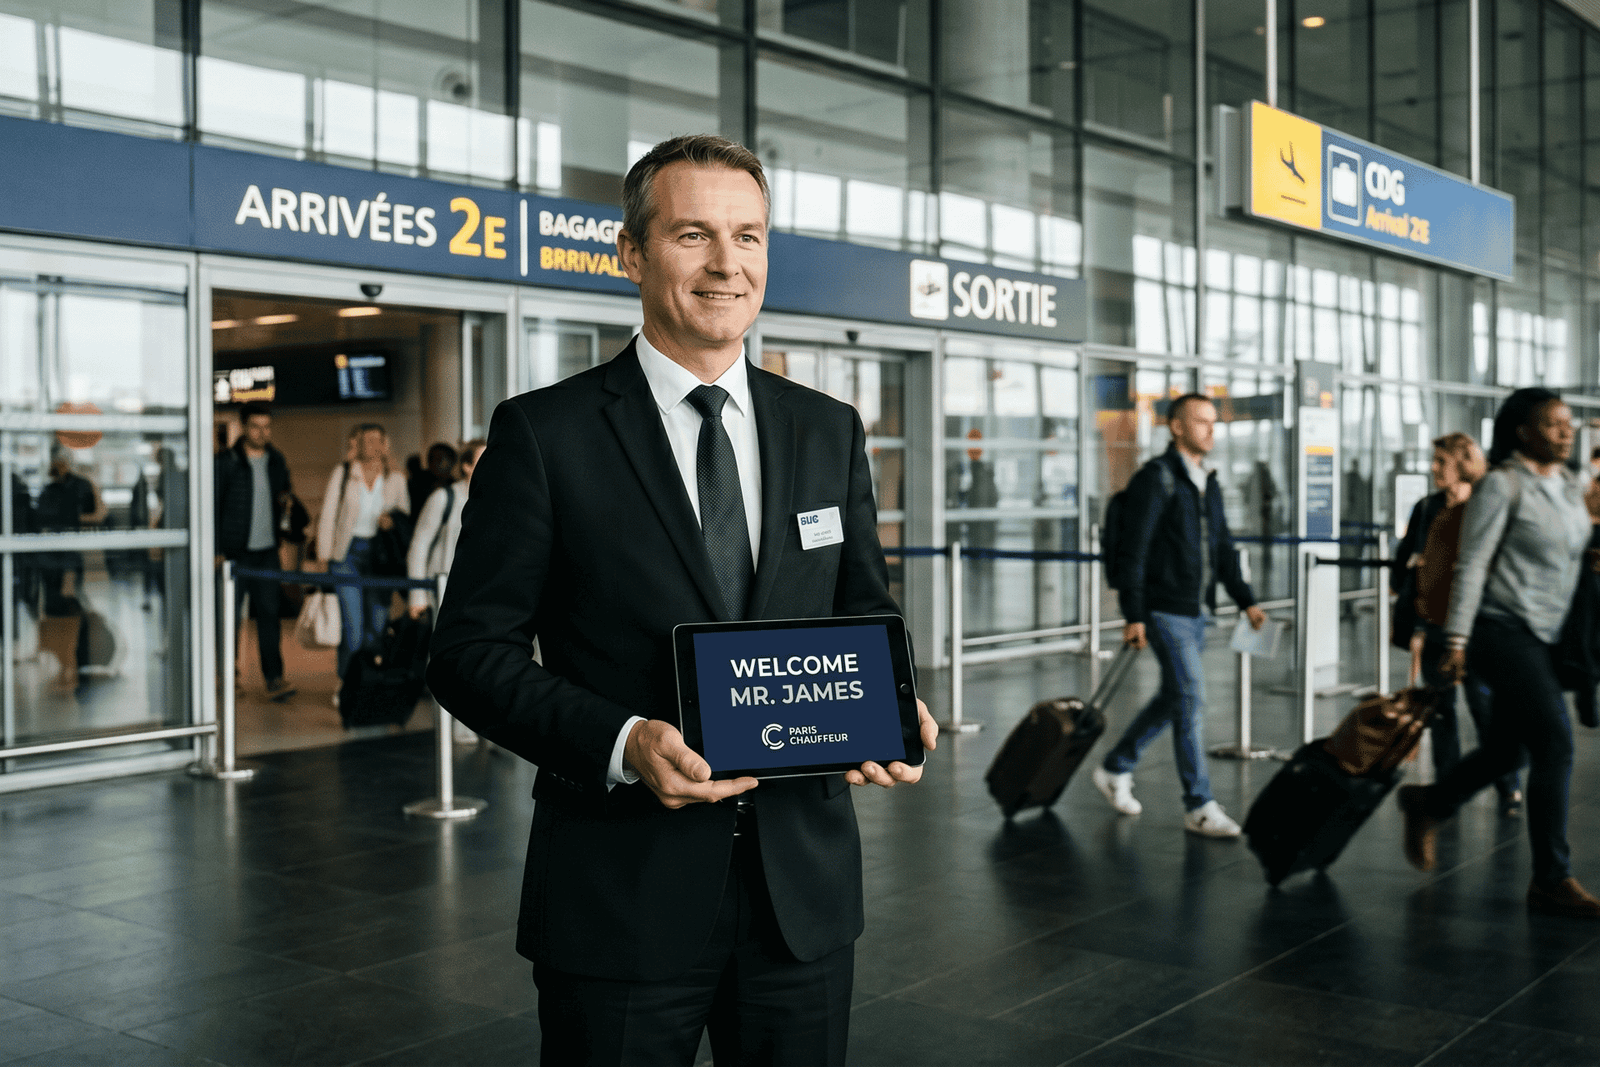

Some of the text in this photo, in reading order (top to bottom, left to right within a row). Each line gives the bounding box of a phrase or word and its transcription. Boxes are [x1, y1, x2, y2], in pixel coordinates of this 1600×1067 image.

[1365, 161, 1406, 206] CDG
[235, 184, 507, 259] ARRIVÉES 2E
[952, 271, 1057, 328] SORTIE
[730, 653, 859, 678] WELCOME
[730, 680, 864, 707] MR. JAMES
[789, 725, 817, 735] PARIS
[789, 733, 848, 745] CHAUFFEUR
